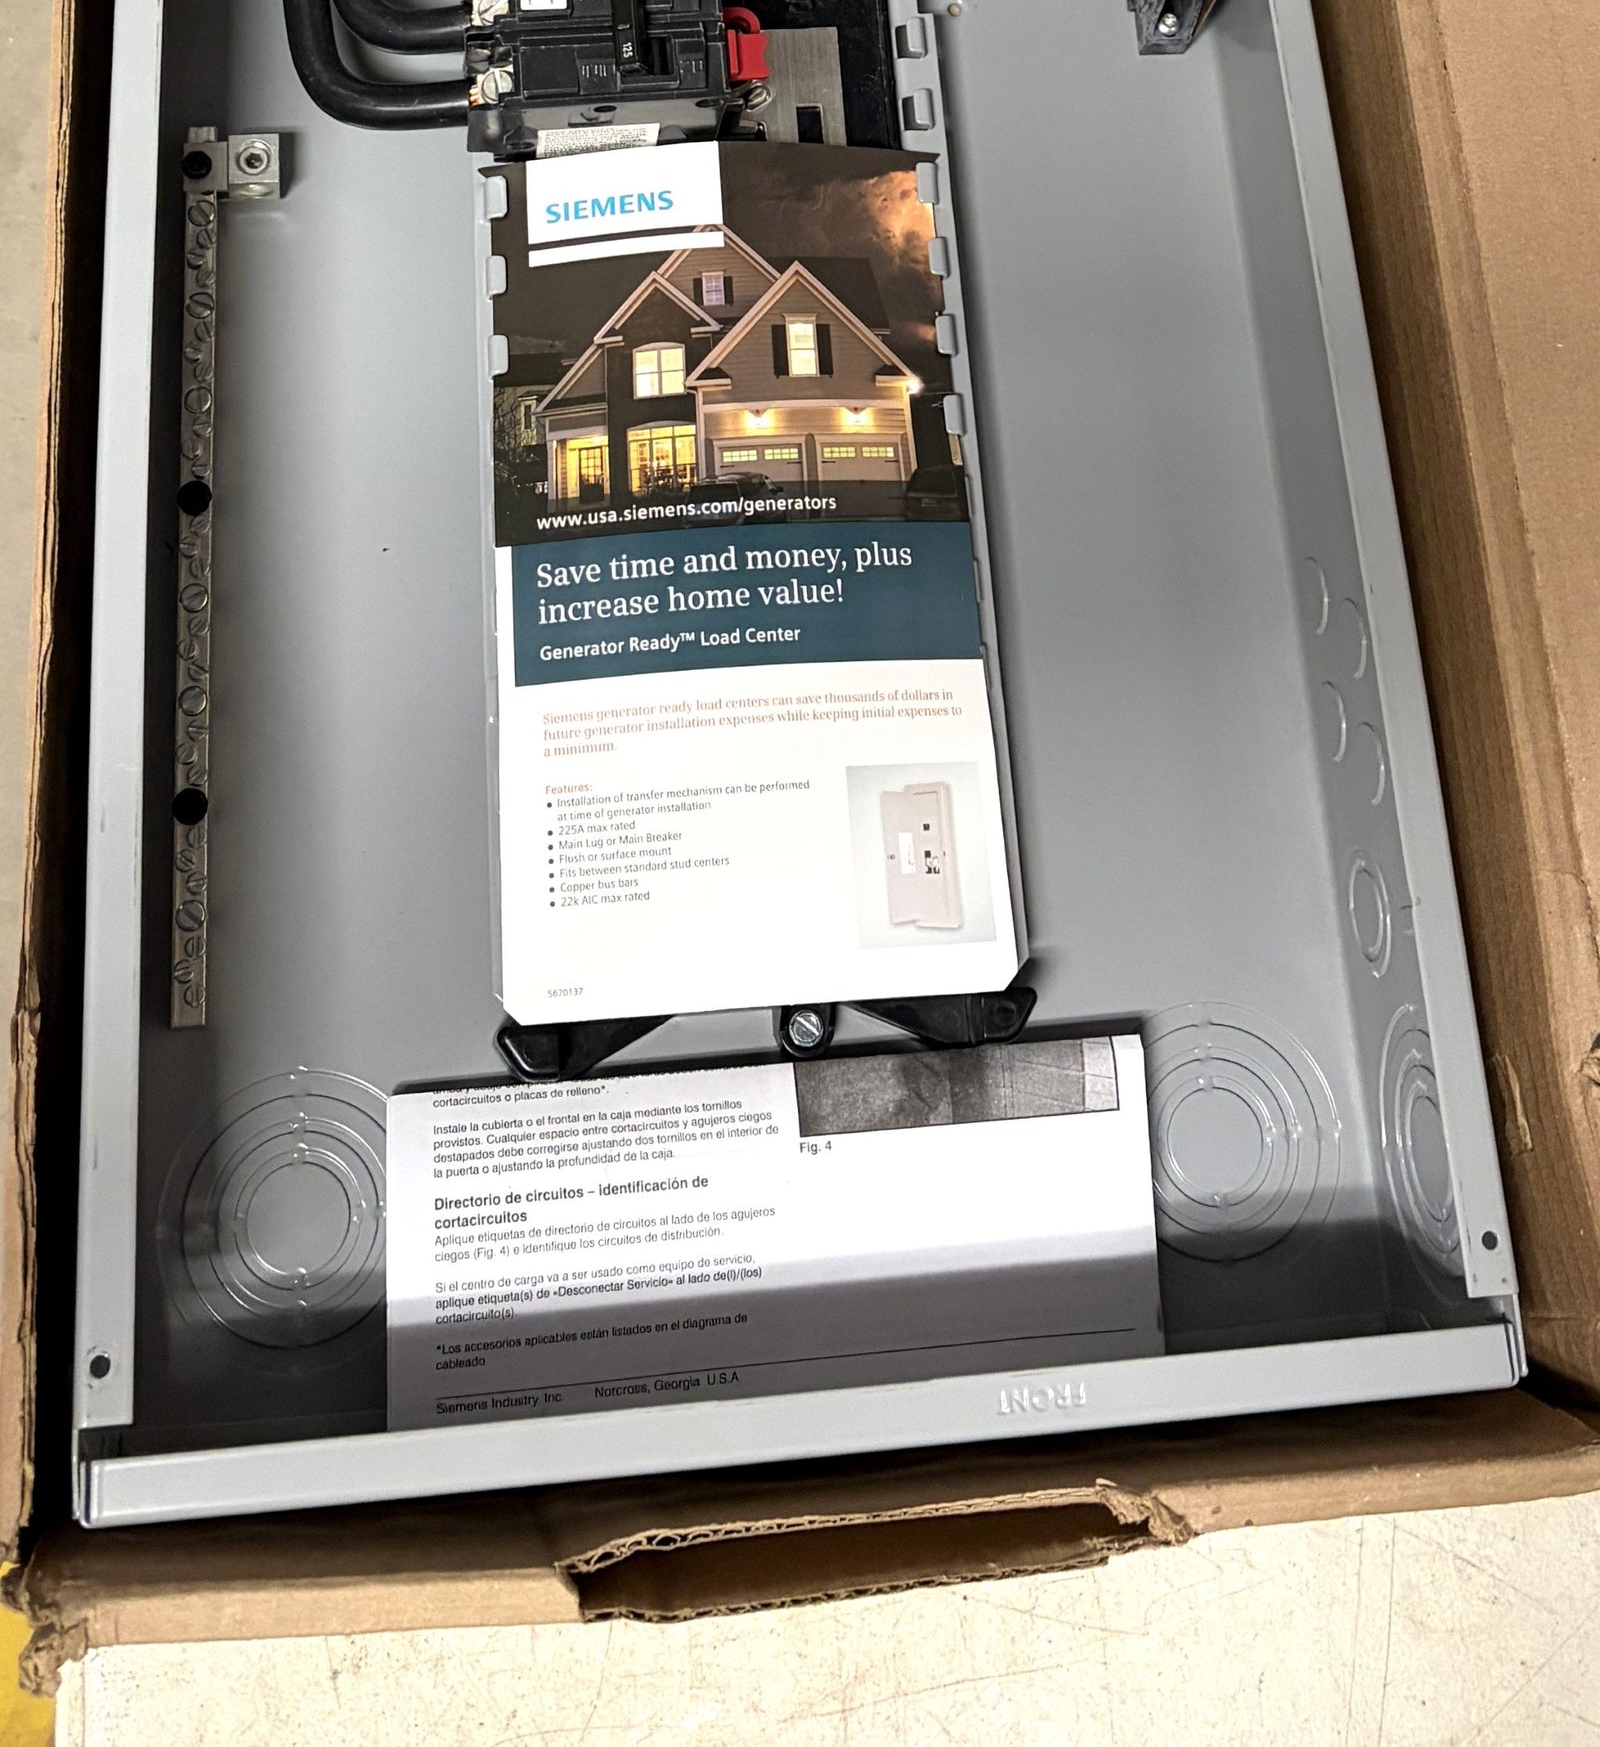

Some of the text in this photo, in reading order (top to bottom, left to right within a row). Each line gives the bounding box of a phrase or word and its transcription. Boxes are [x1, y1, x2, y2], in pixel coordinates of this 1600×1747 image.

[622, 41, 633, 59] 125
[545, 190, 674, 224] SIEMENS
[537, 495, 836, 530] www.usa.siemens.com/generators
[537, 542, 911, 587] Save time and money, plus
[539, 579, 842, 624] increase home value!
[540, 628, 800, 660] Generator Ready™ Load Center
[543, 689, 953, 725] Siemens generator ready load centers can save thousands of dollars in
[544, 706, 962, 741] future generator installation expenses while keeping initial expenses to
[544, 743, 618, 757] a minimum.
[546, 784, 592, 794] Features:
[557, 780, 809, 807] Installation of transfer mechanism can be performed
[558, 802, 711, 821] at time of generator installation
[559, 820, 635, 835] 225A max rated
[559, 831, 682, 849] Main Lug or Main Breaker
[559, 853, 585, 863] Flush
[601, 850, 636, 860] surface
[639, 847, 671, 857] mount
[560, 858, 729, 878] Fits between standard stud centers
[560, 878, 638, 893] Copper bus bars
[561, 891, 650, 907] 22k AIC max rated
[547, 987, 584, 999] 5670137
[433, 1095, 501, 1108] cortacircuitos
[504, 1094, 511, 1102] o
[514, 1091, 547, 1103] placas
[550, 1089, 563, 1098] de
[434, 1100, 742, 1134] Instale la cubierta o el frontal en la caja mediante los tornillos
[487, 1132, 536, 1144] Cualquier
[539, 1128, 579, 1140] espacio
[582, 1126, 608, 1136] entre
[611, 1120, 679, 1133] cortacircuitos
[682, 1120, 688, 1129] y
[691, 1116, 735, 1128] agujeros
[738, 1112, 772, 1123] ciegos
[800, 1141, 832, 1155] Fig. 4
[435, 1194, 500, 1210] Directorio
[505, 1192, 521, 1204] de
[526, 1188, 583, 1202] circuitos
[599, 1177, 688, 1196] identificación
[692, 1176, 708, 1188] de
[435, 1212, 527, 1229] cortacircuitos
[464, 1338, 521, 1353] accesorios
[525, 1332, 577, 1348] aplicables
[580, 1328, 609, 1340] están
[612, 1324, 652, 1336] listados
[655, 1323, 668, 1332] en
[671, 1320, 680, 1330] el
[683, 1316, 731, 1330] diagrama
[734, 1313, 747, 1323] de
[436, 1356, 485, 1371] cableado
[654, 1376, 700, 1391] Georgia
[436, 1401, 487, 1414] Siemens
[996, 1382, 1086, 1416] FRONT
